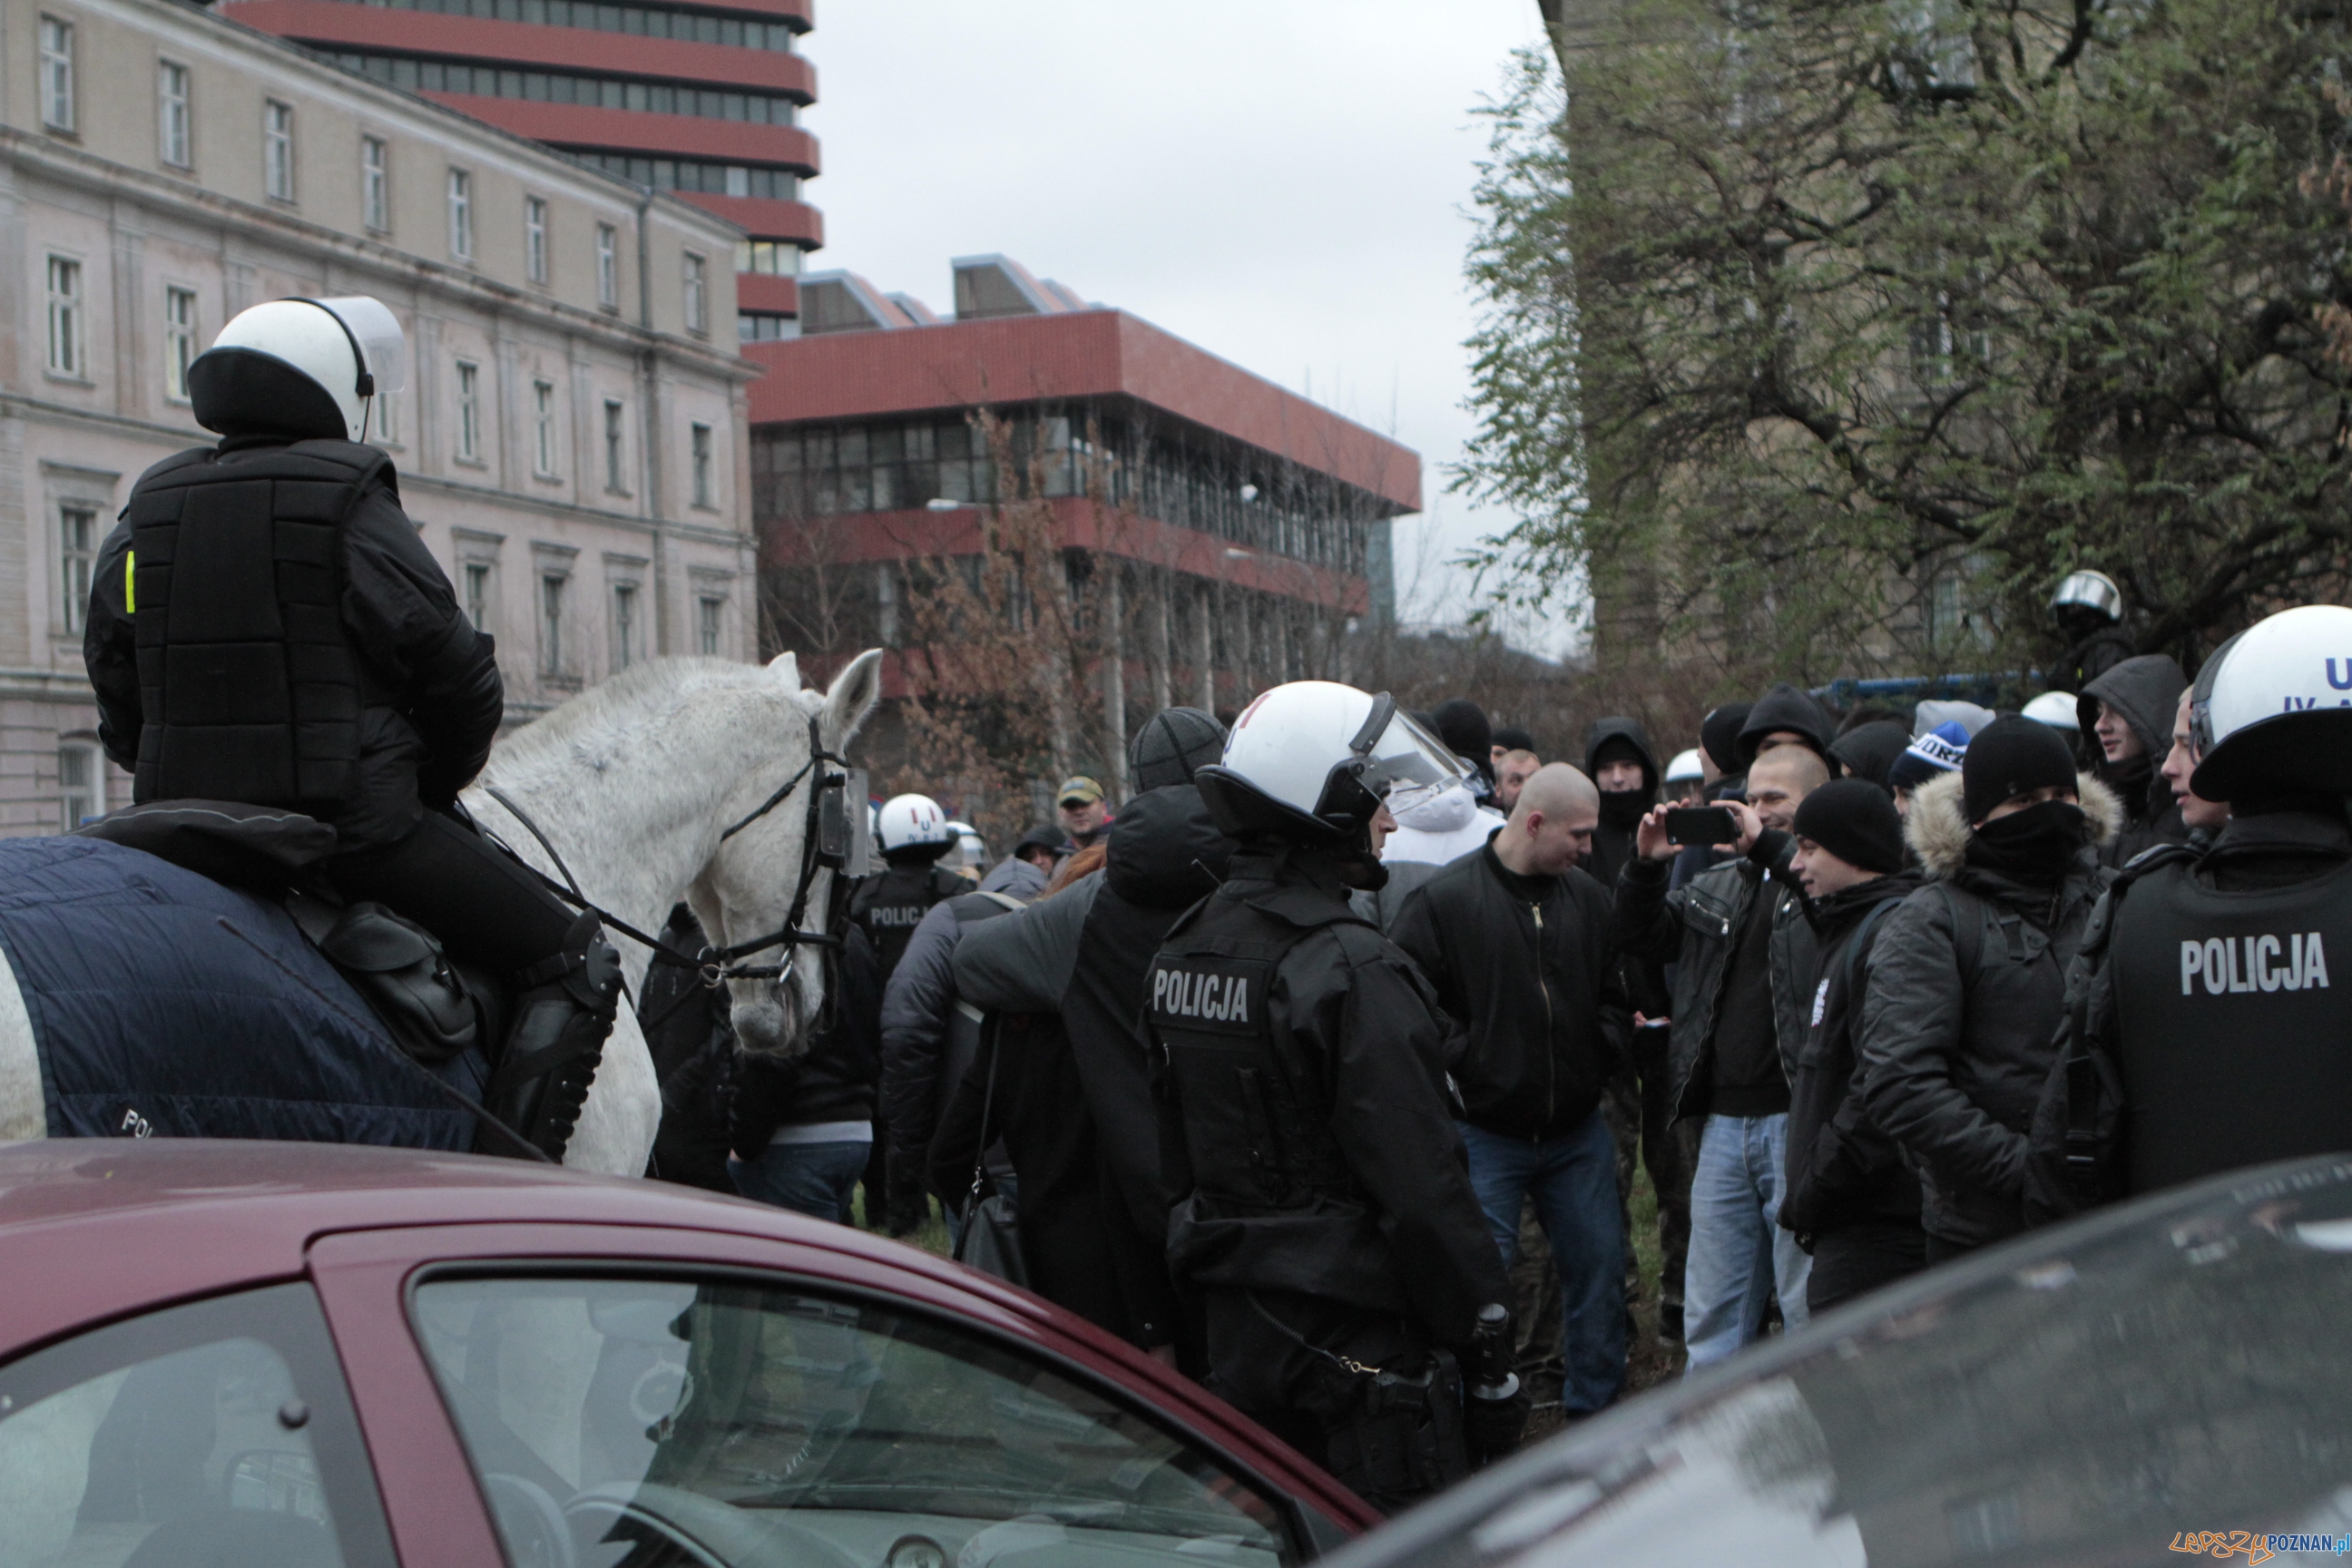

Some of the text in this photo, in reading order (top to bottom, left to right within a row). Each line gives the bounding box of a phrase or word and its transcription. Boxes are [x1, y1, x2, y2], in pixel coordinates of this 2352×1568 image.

[920, 819, 931, 832] U
[871, 906, 929, 926] POLICJ
[2180, 931, 2330, 996] POLICJA
[1153, 968, 1249, 1023] POLICJA
